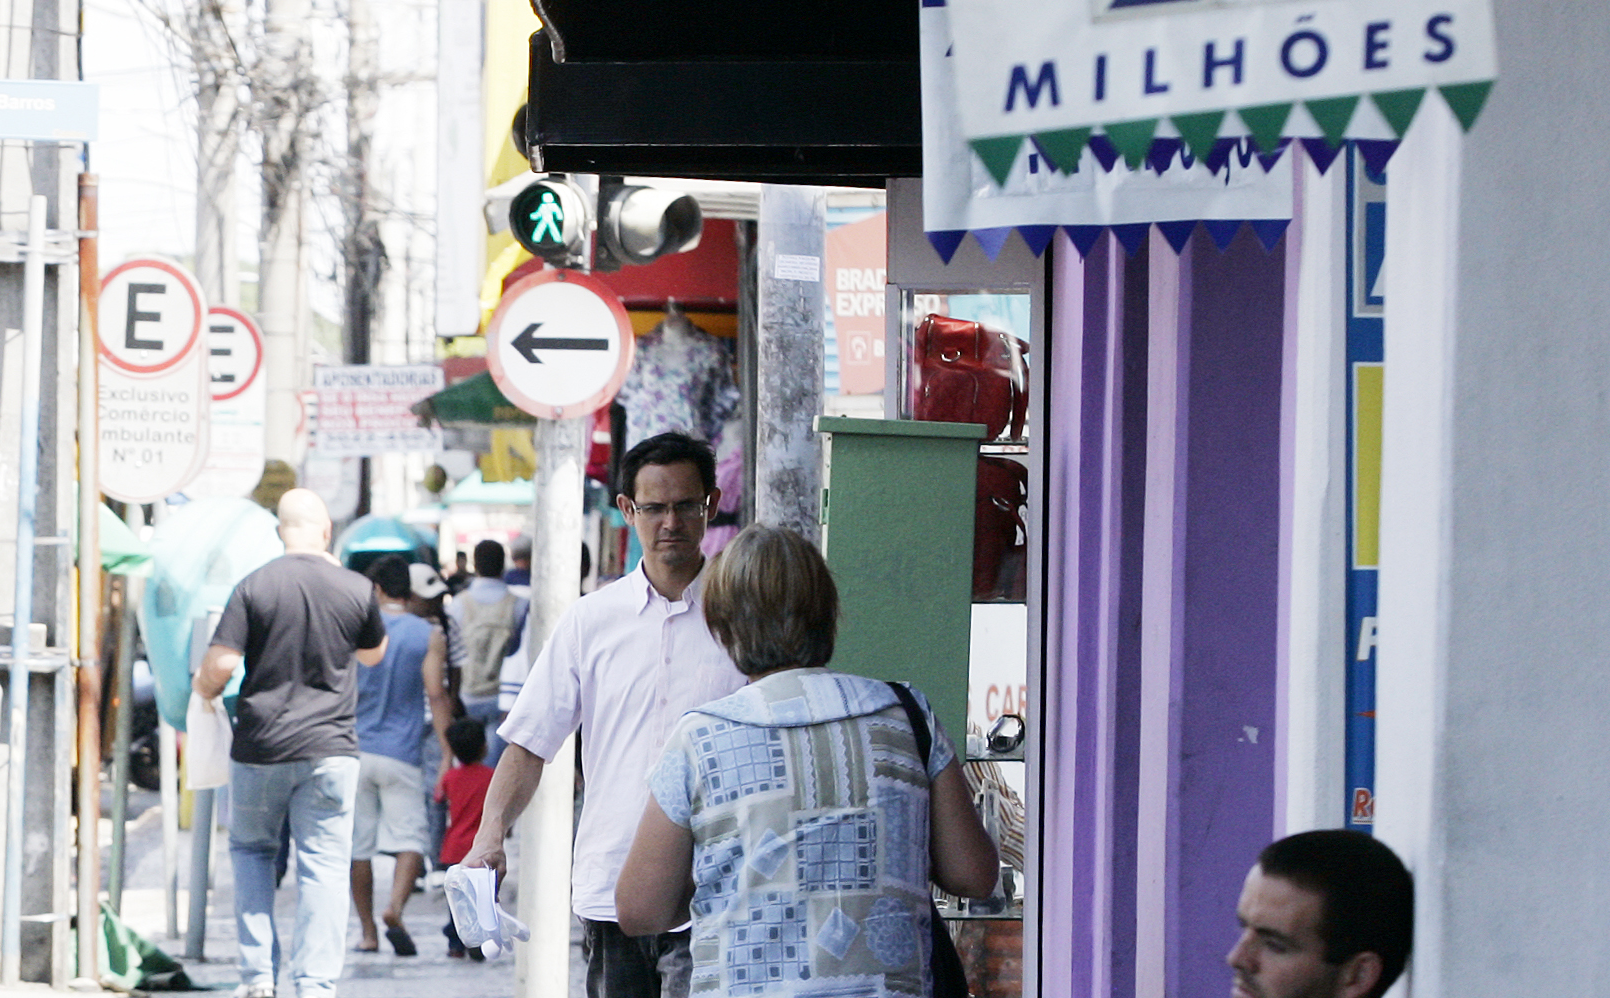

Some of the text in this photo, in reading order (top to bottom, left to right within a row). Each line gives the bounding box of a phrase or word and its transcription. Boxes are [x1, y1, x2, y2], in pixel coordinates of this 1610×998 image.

[1003, 14, 1457, 113] MILHÕES
[836, 267, 886, 292] BRAD
[125, 282, 167, 350] E
[98, 384, 190, 404] Exclusivo
[98, 403, 191, 423] Comércio
[101, 427, 196, 445] mbulante
[142, 449, 164, 464] 01
